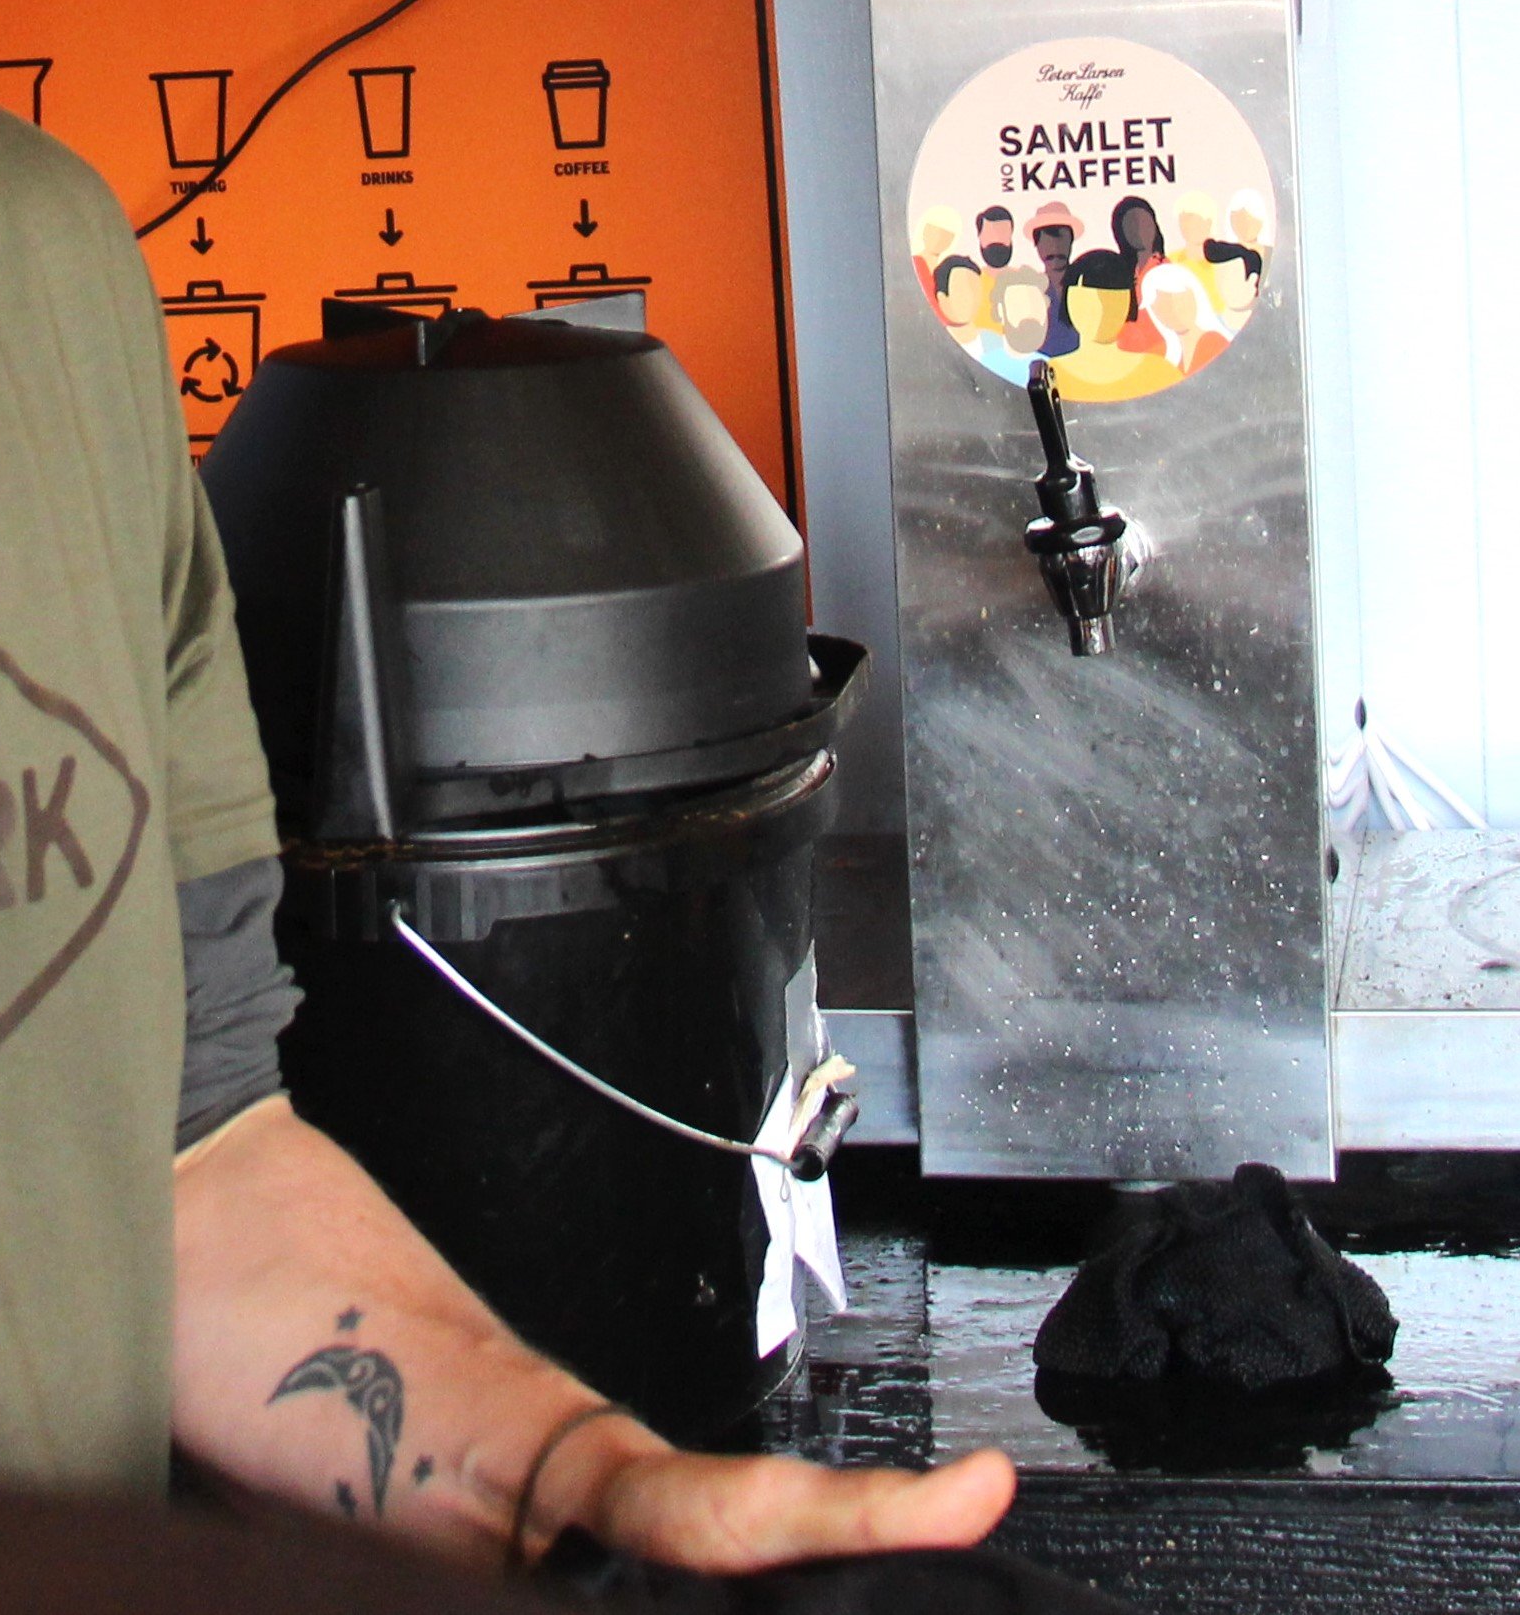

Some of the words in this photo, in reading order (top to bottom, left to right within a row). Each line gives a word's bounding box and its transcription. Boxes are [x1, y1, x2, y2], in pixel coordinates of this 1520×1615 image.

[1036, 63, 1077, 83] Peter
[1075, 62, 1126, 81] Larsen
[999, 117, 1172, 157] SAMLET
[361, 170, 414, 186] DRINKS
[554, 160, 611, 176] COFFEE
[1000, 163, 1015, 193] OM
[1020, 155, 1177, 191] KAFFEN
